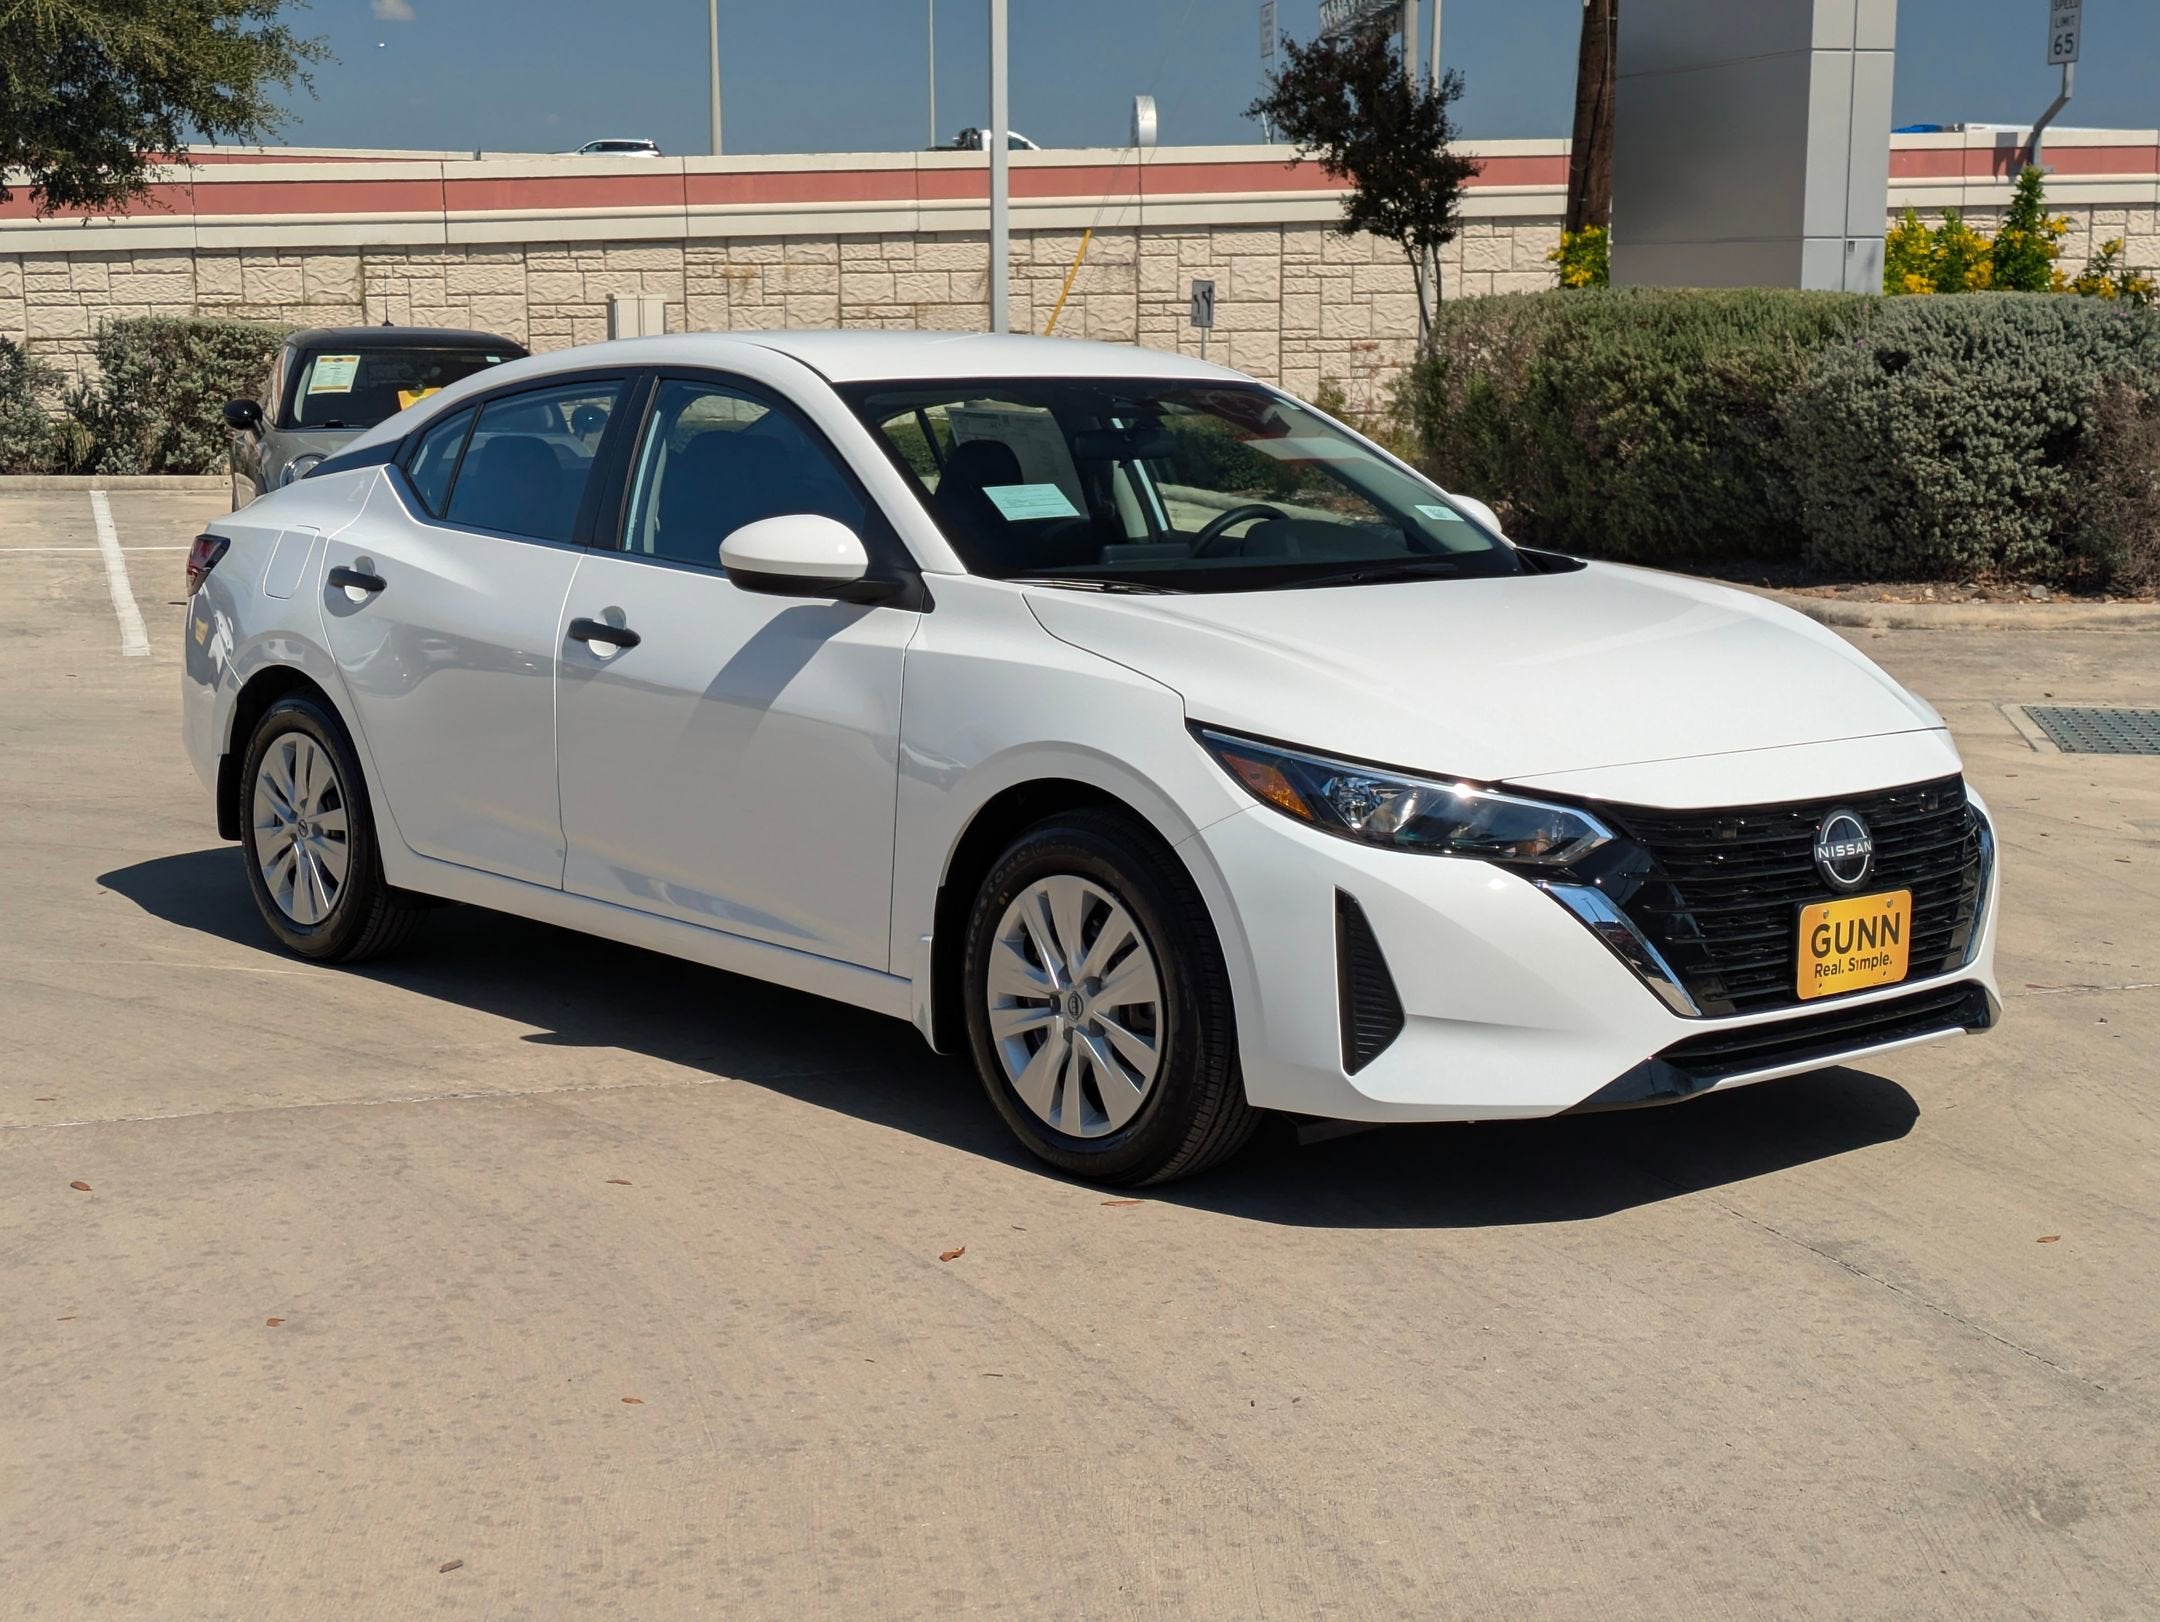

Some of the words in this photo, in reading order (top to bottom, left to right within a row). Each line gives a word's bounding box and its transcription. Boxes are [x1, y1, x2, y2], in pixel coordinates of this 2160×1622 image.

[2054, 33, 2074, 55] 65
[1818, 840, 1872, 859] NISSAN
[1811, 912, 1901, 959] GUNN
[1814, 961, 1844, 979] Real.
